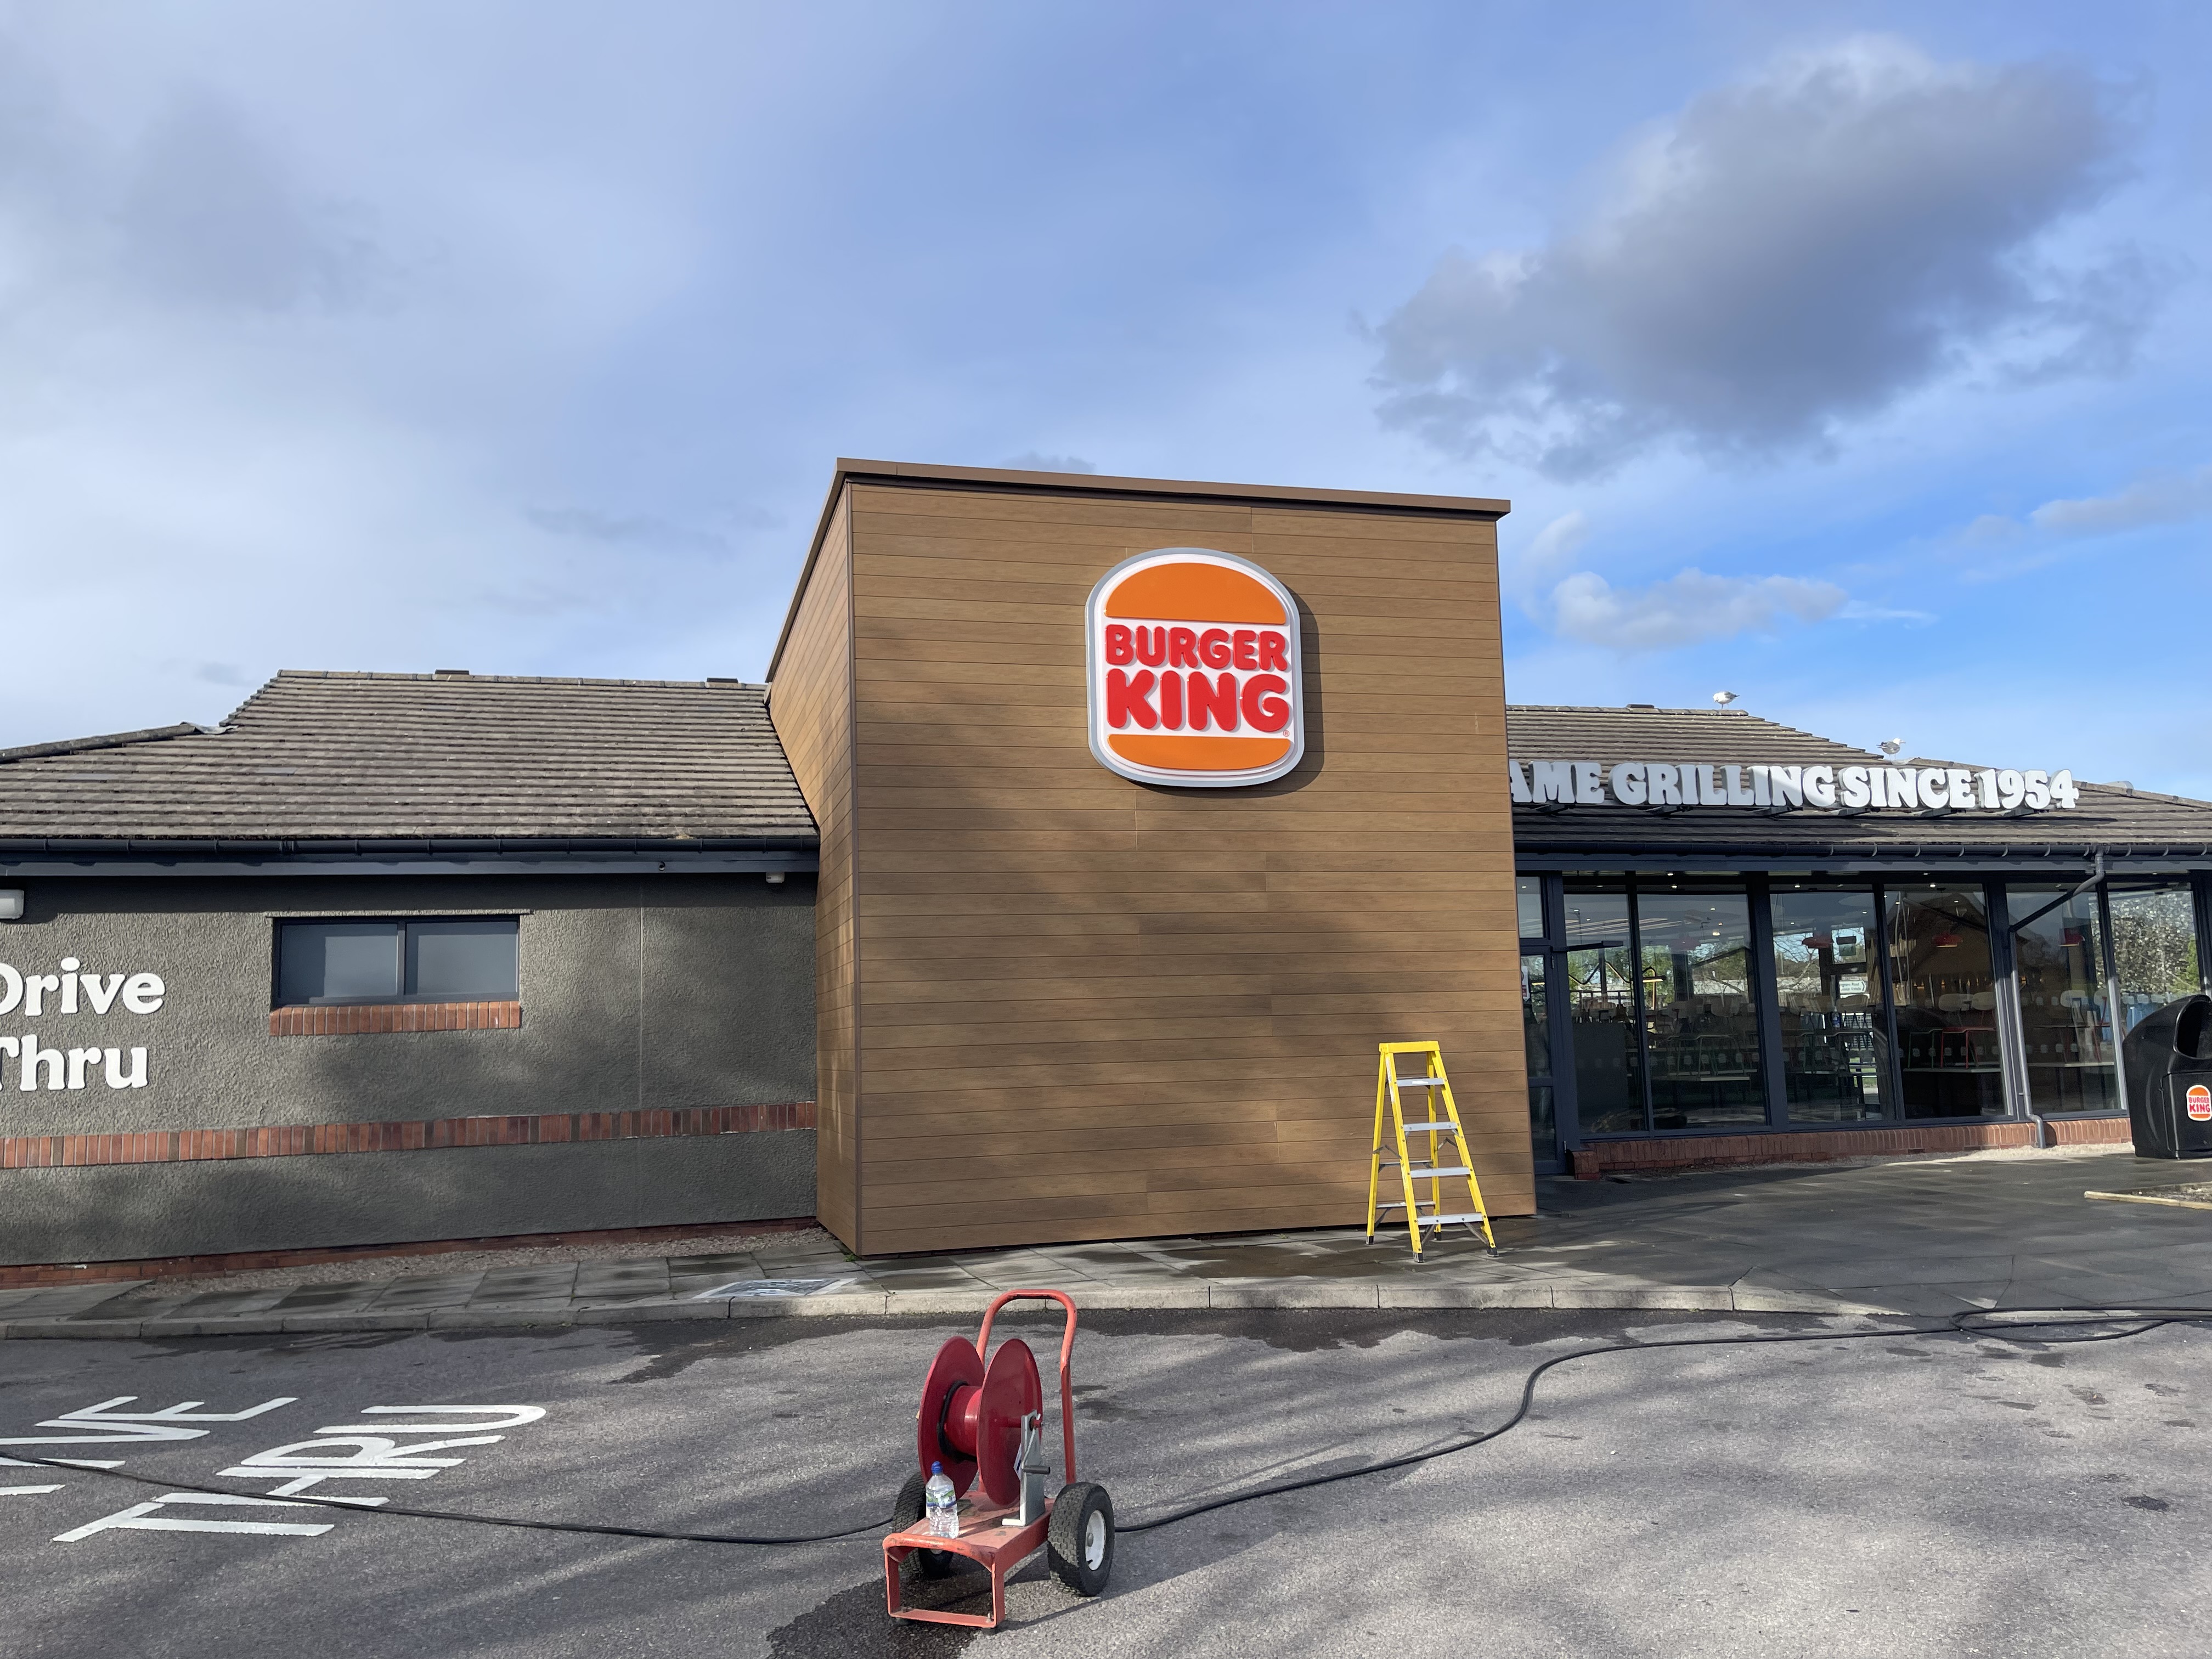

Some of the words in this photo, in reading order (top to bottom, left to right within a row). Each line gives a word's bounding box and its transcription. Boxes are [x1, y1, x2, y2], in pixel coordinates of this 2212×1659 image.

[1104, 624, 1288, 672] BURGER
[1105, 668, 1290, 733] KING
[1608, 762, 1836, 808] GRILLING
[1838, 766, 1975, 809] SINCE
[1975, 769, 2079, 810] 1954
[2189, 1104, 2210, 1113] KING
[52, 1405, 547, 1543] THRU
